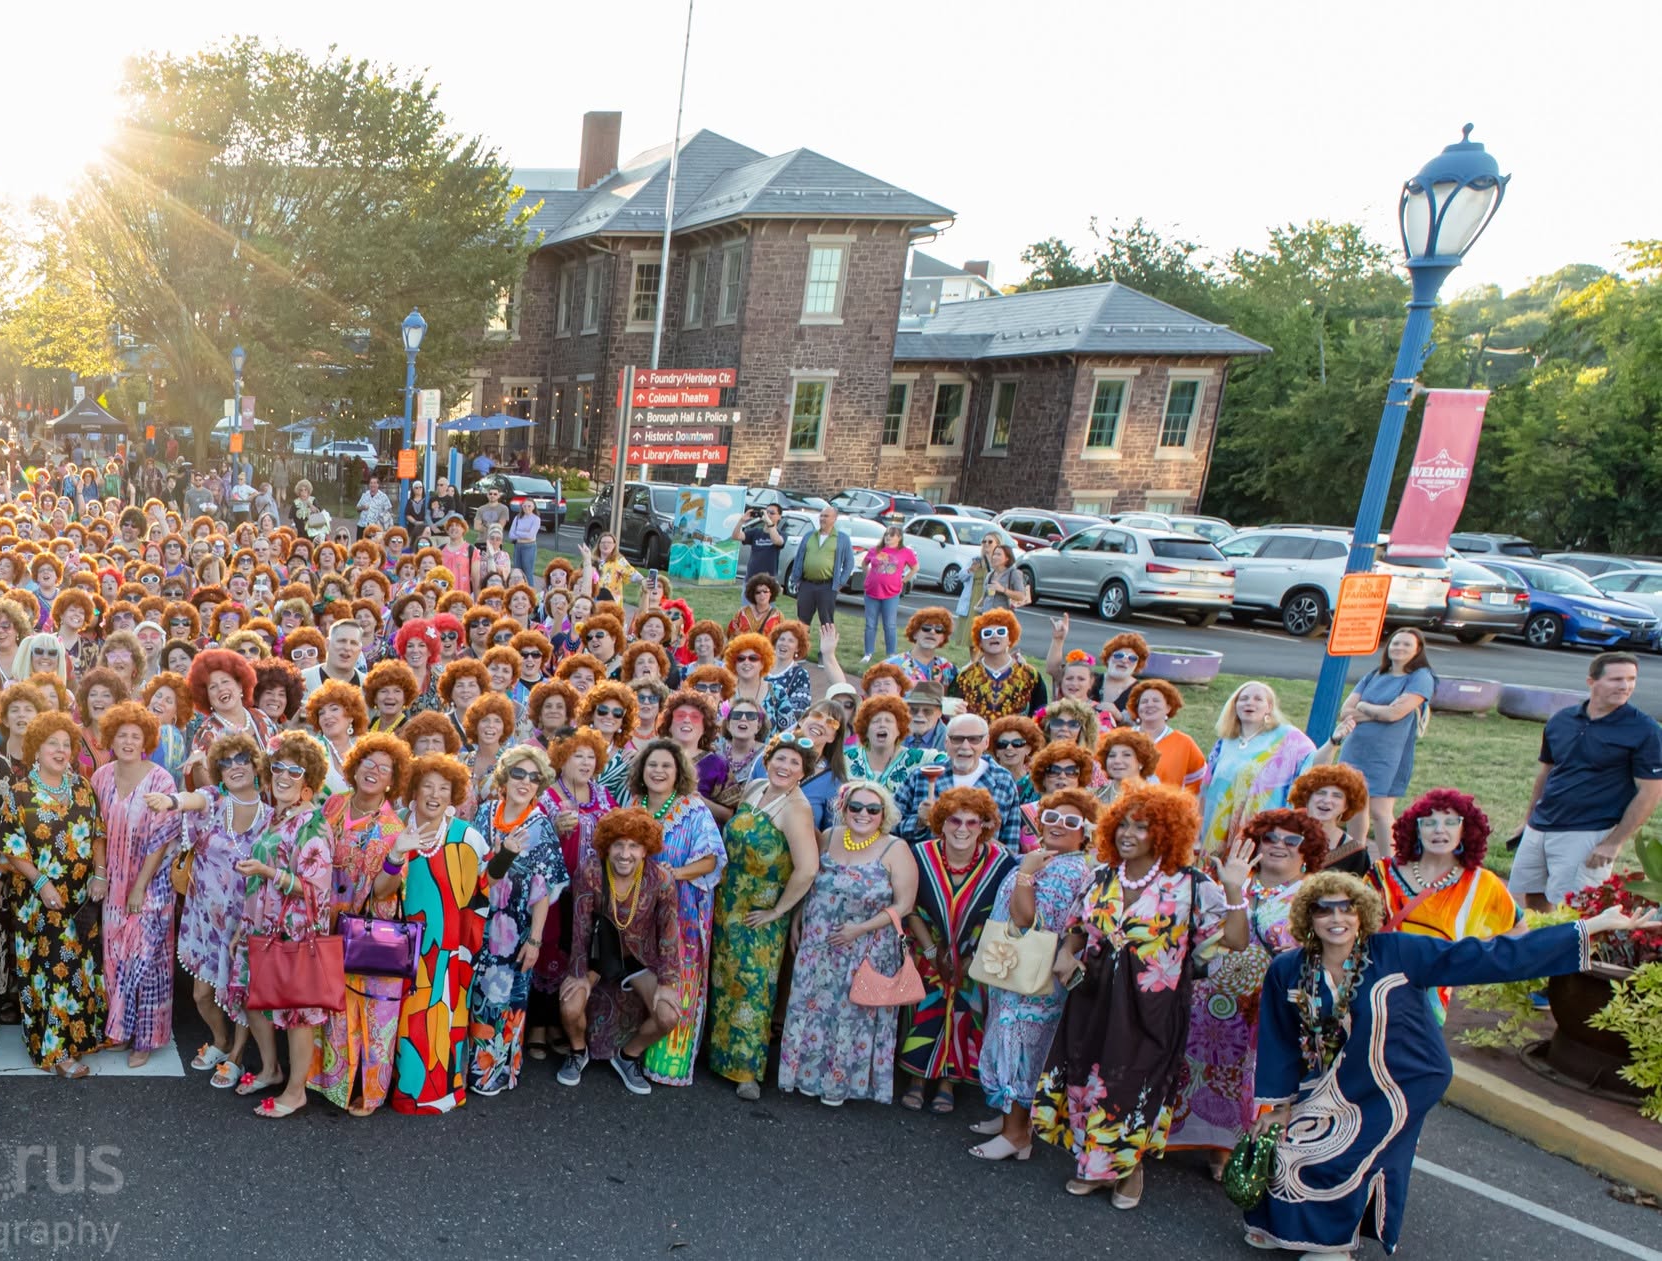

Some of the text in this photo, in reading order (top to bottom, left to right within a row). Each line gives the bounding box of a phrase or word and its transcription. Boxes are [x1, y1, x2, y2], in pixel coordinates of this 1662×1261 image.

[650, 372, 731, 386] Foundry/Heritage Ctr.
[648, 392, 709, 403] Colonial Theatre
[646, 412, 728, 425] Borough Hall & Police
[645, 431, 714, 441] Historic Downtown
[643, 449, 720, 463] Library/Reeves Park
[1410, 466, 1468, 479] WELCOME
[1359, 584, 1373, 593] NO
[1345, 591, 1384, 599] PARKING
